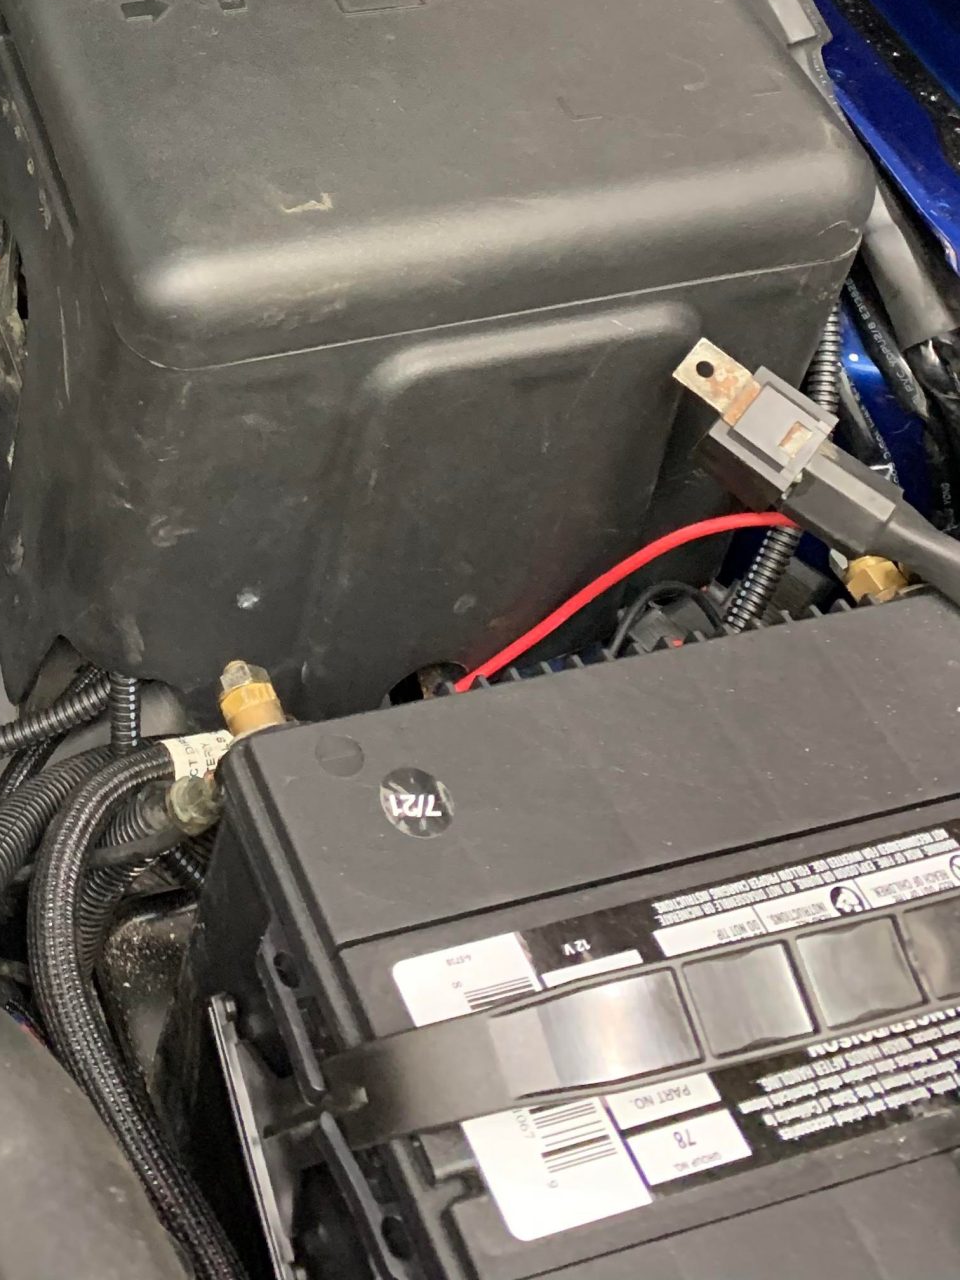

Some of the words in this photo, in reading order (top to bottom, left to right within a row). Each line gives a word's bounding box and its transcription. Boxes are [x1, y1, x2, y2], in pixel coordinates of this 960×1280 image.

[389, 794, 442, 818] 7/21
[728, 922, 747, 937] NOT
[563, 942, 575, 955] V
[573, 938, 590, 951] 12
[656, 1083, 691, 1103] PART
[628, 1094, 655, 1111] NO.
[672, 1127, 696, 1150] 78
